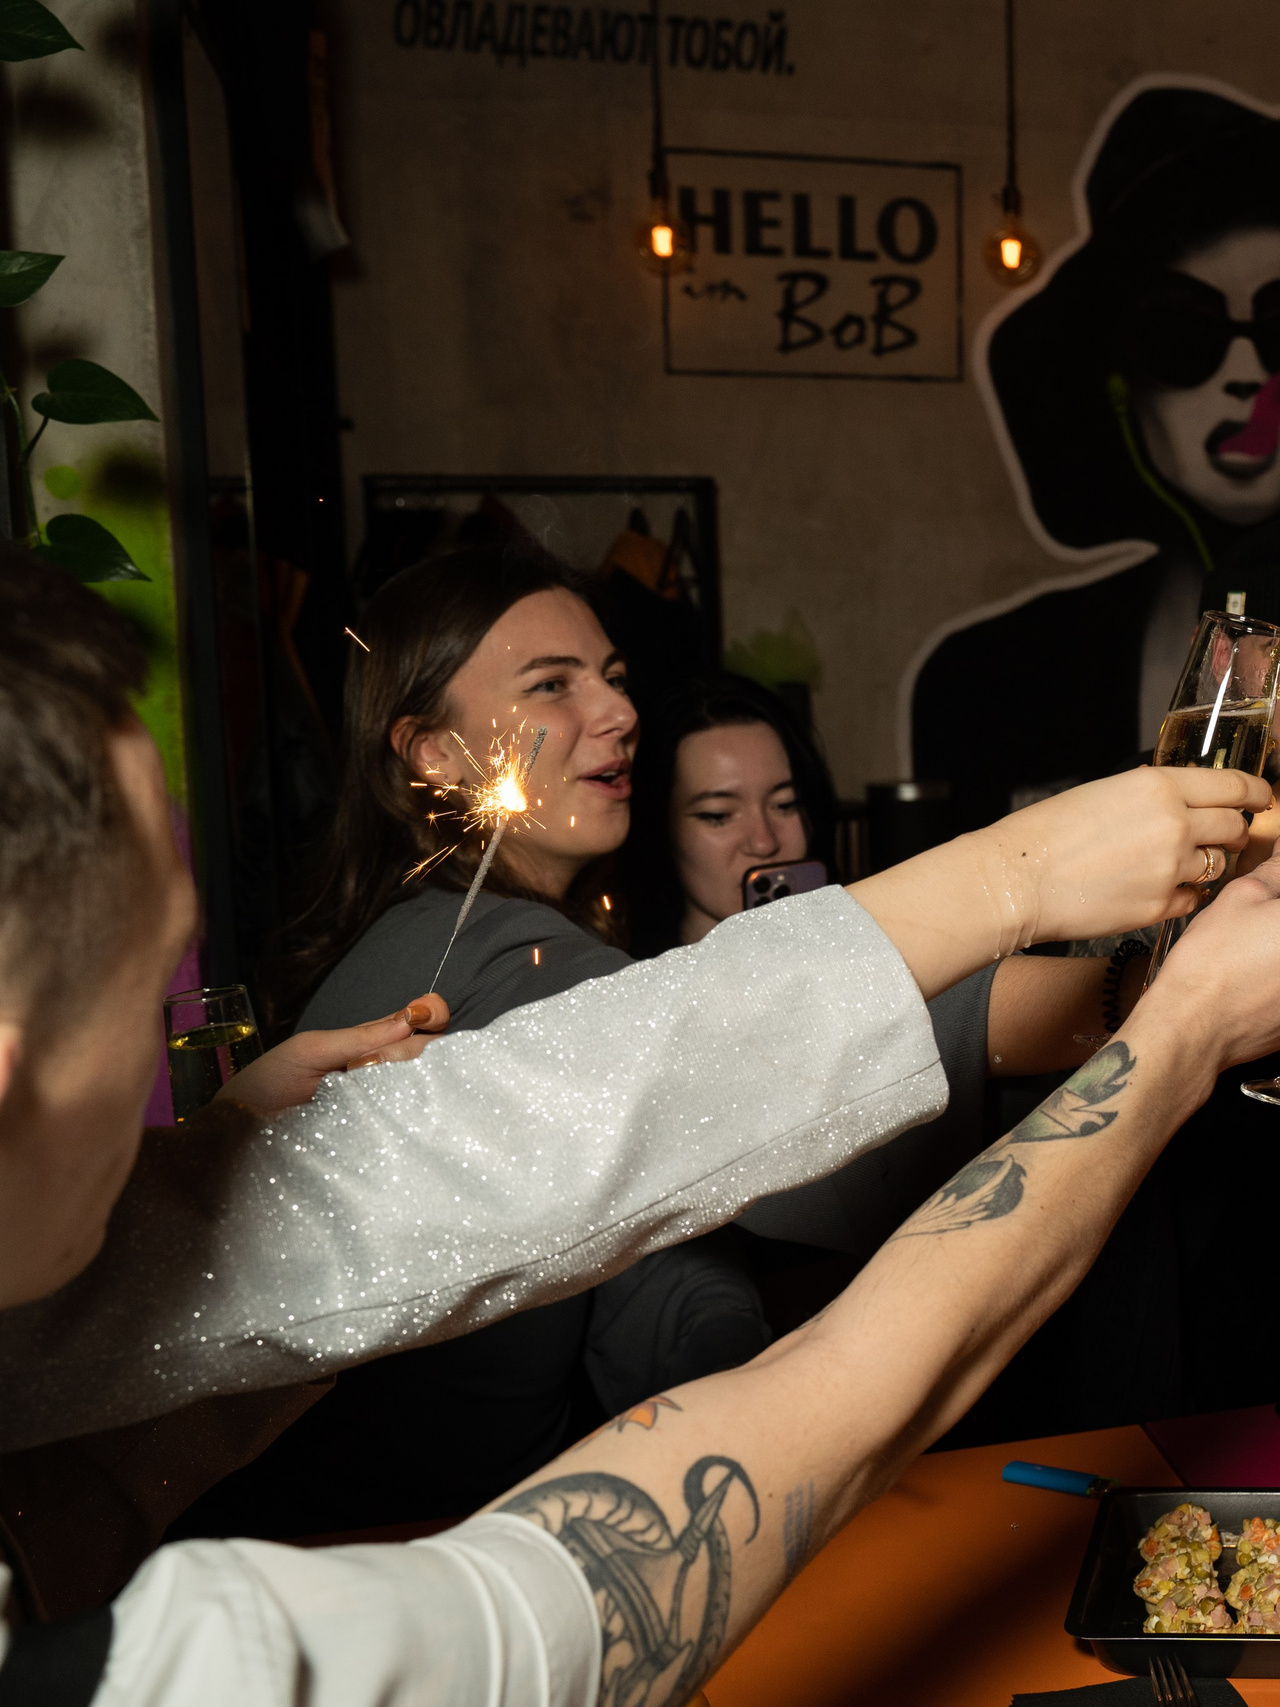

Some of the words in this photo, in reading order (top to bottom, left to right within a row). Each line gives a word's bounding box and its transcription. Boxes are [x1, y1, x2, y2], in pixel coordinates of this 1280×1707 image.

[393, 0, 657, 66] ОВЛАДЕВАЮТ
[666, 10, 796, 75] ТОБОЙ.
[678, 187, 938, 264] HELLO
